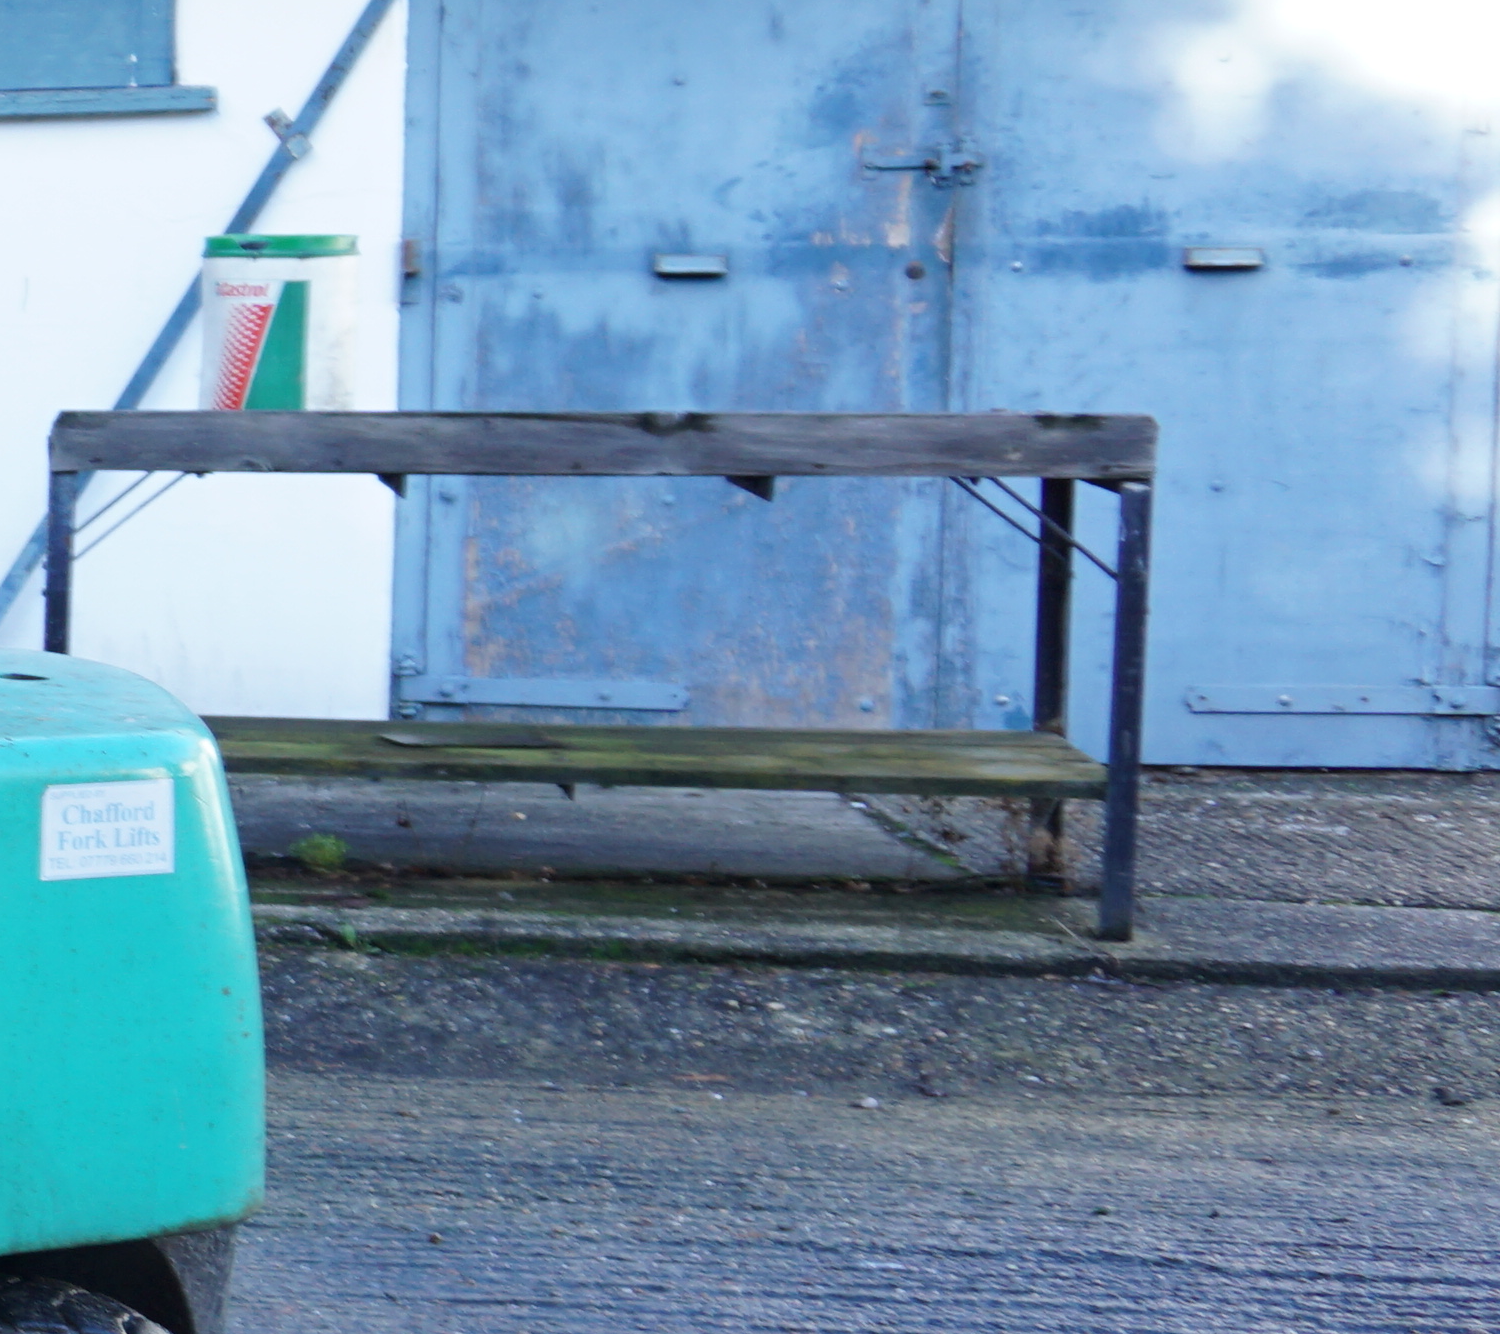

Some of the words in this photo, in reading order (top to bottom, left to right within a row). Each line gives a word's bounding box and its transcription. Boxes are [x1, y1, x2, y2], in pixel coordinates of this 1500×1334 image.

[62, 802, 155, 824] Chafford
[57, 829, 108, 850] Fork
[115, 827, 160, 847] Lifts
